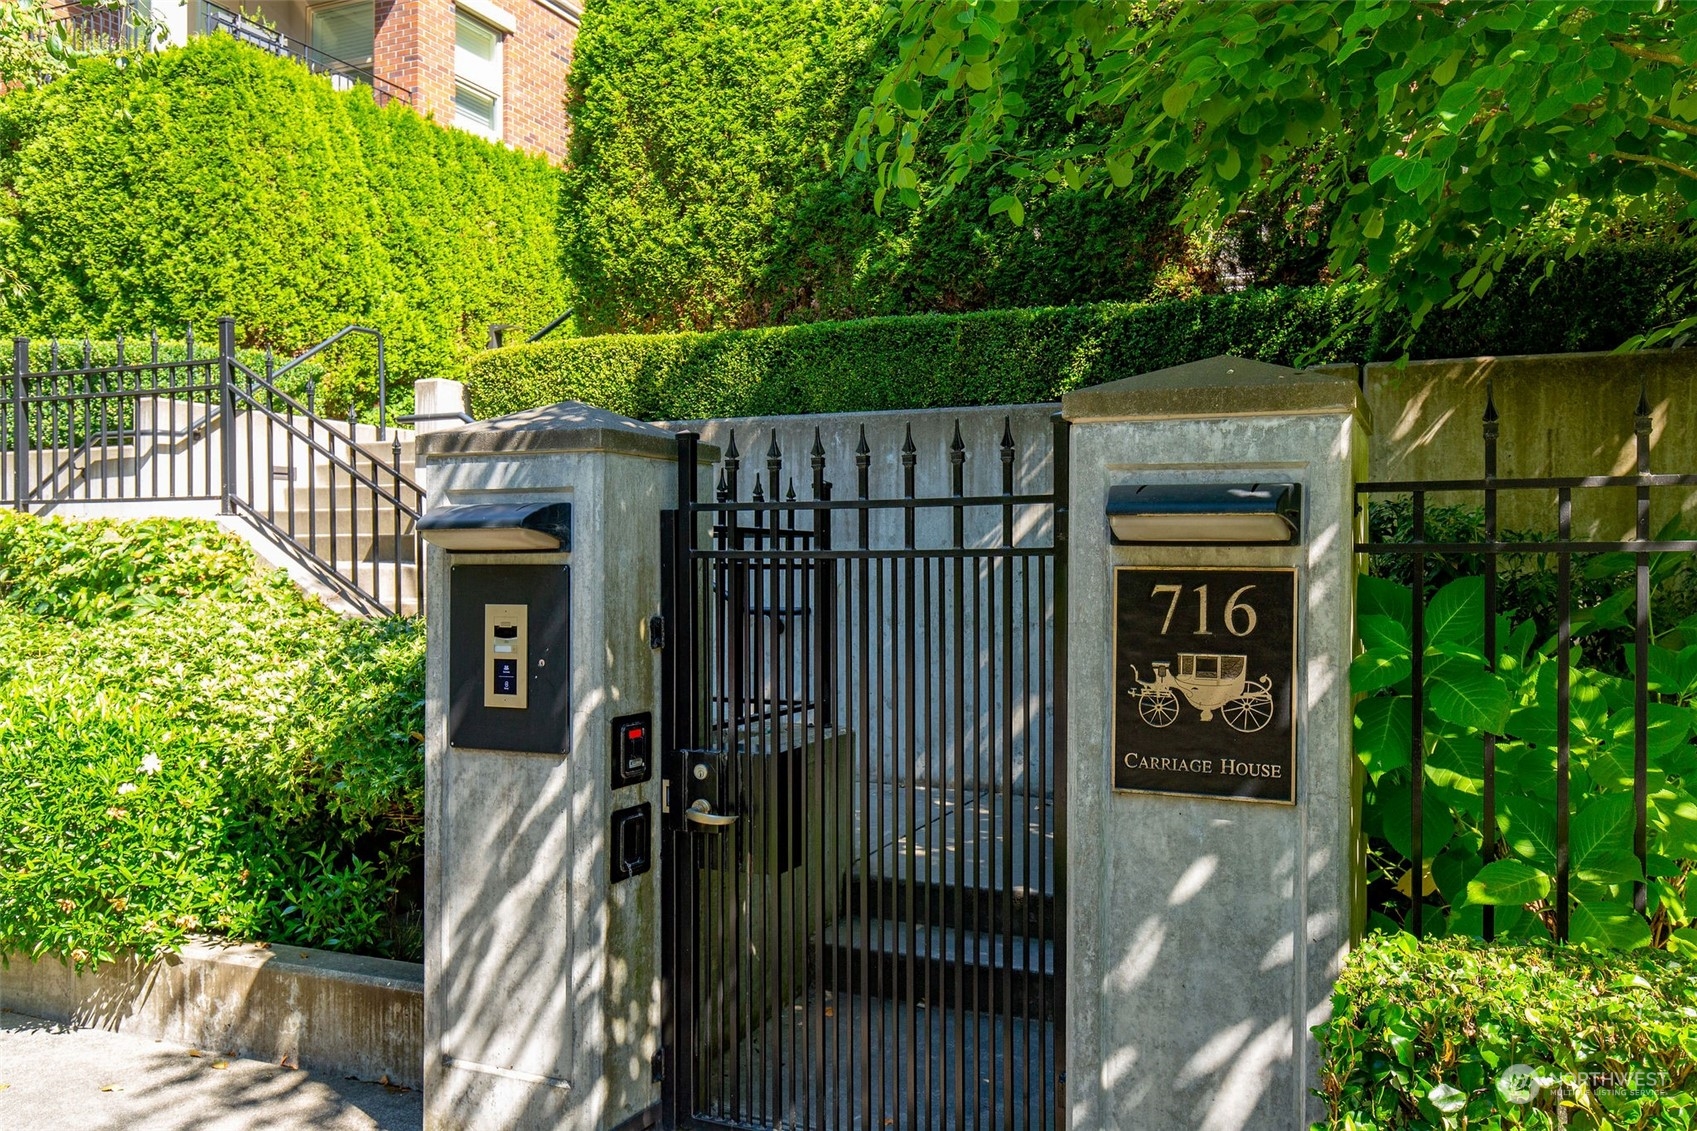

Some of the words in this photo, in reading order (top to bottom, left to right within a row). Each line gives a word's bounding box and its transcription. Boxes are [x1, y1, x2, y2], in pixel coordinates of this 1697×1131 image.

[1151, 584, 1257, 637] 716
[1124, 753, 1212, 774] CARRIAGE
[1220, 759, 1282, 778] HOUSE
